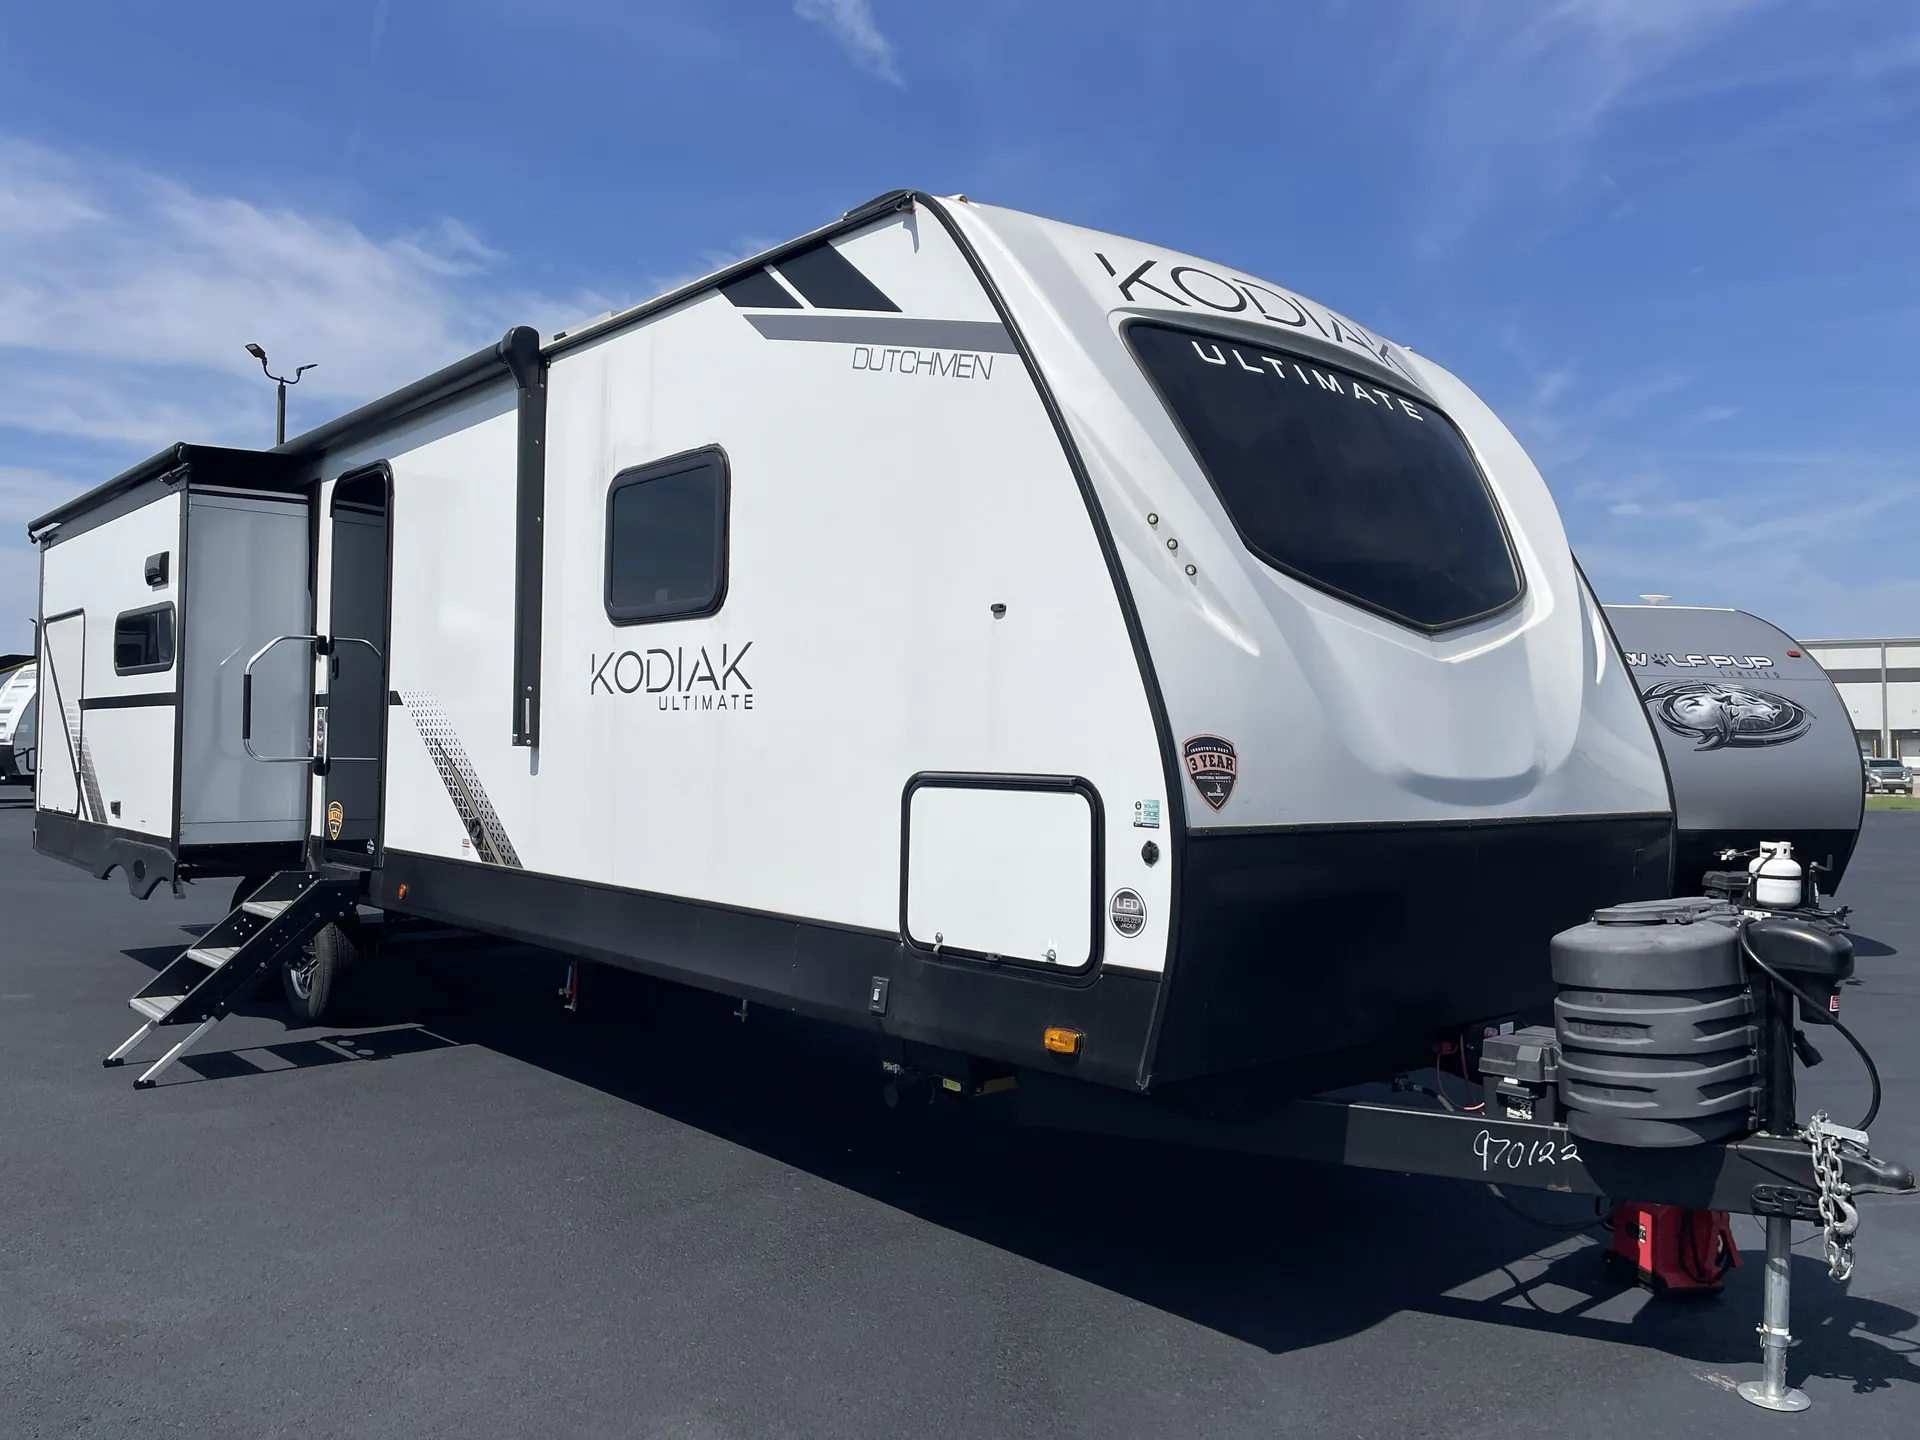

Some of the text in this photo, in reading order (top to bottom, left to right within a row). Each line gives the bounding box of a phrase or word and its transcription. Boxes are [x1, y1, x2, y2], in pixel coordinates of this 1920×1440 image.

[1094, 252, 1419, 386] KODIAK
[852, 346, 994, 380] DUTCHMEN
[1191, 340, 1423, 421] ULTIMATE
[590, 641, 754, 695] KODIAK
[1719, 670, 1781, 679] LIMITED
[658, 694, 753, 711] ULTIMATE
[1189, 754, 1234, 772] 3 YEAR
[1116, 897, 1140, 910] LED
[1115, 916, 1142, 925] STABILIZER
[1120, 922, 1137, 930] JACKS
[1597, 1025, 1632, 1039] GAS
[1472, 1129, 1584, 1171] 970122
